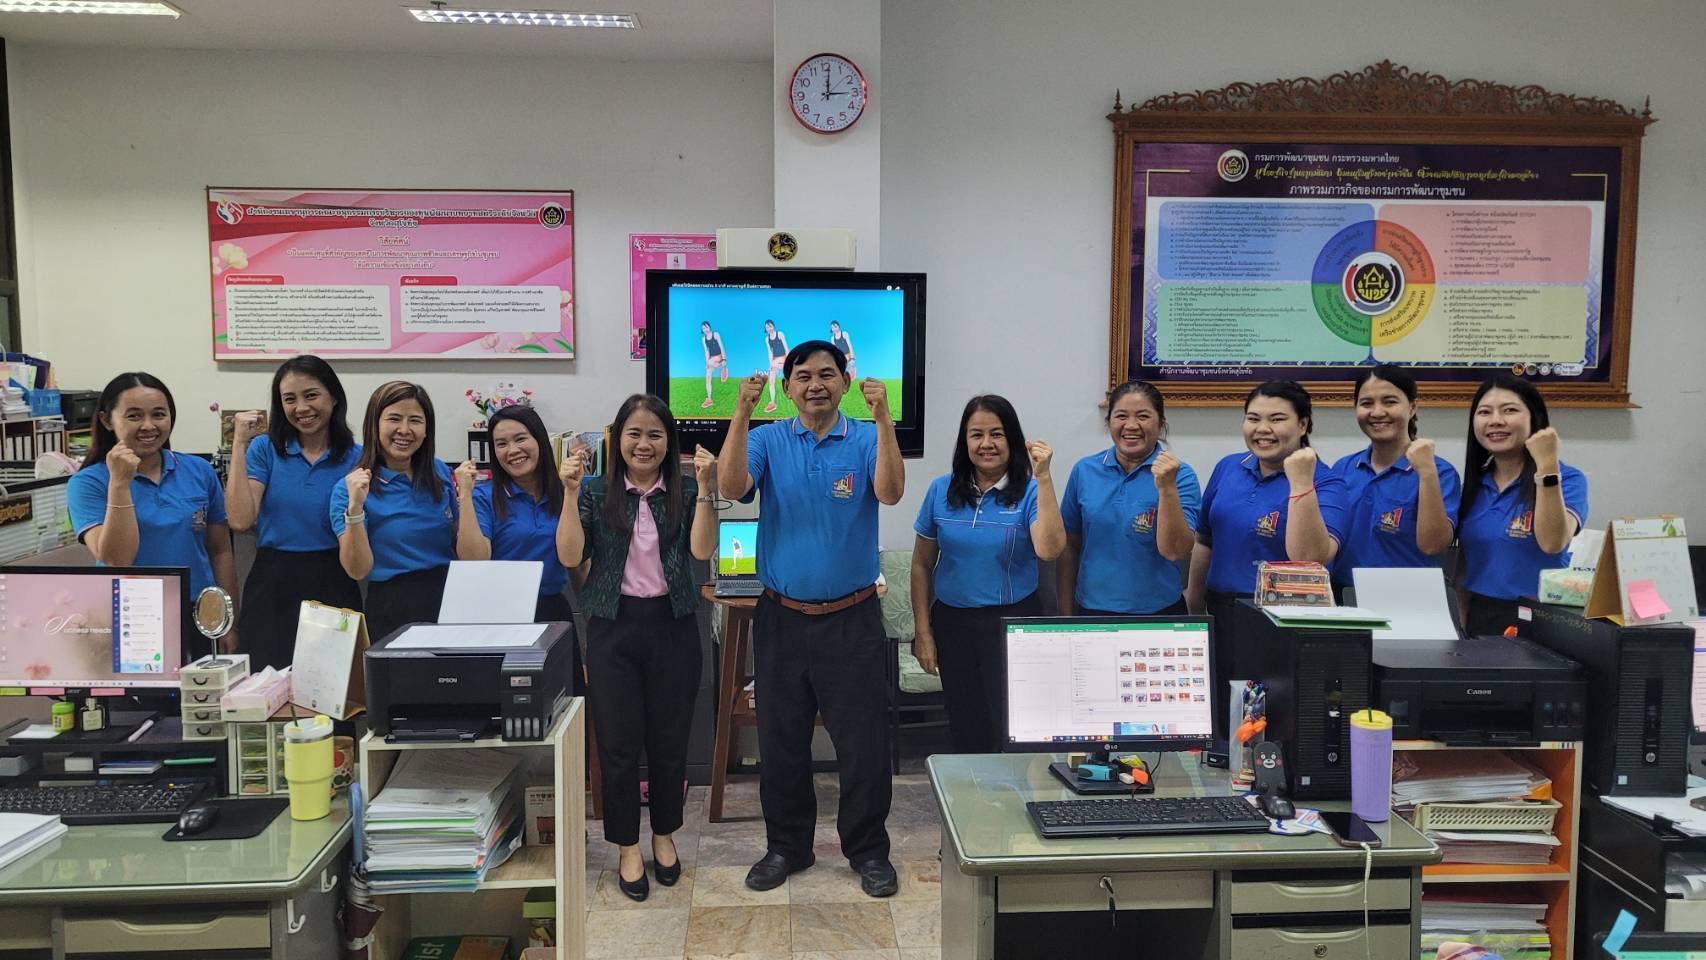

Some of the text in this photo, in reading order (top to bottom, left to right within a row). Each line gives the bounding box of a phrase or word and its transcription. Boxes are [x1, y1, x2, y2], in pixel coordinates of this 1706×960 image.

[810, 67, 817, 76] 11
[821, 62, 830, 72] 12
[838, 65, 842, 75] 1
[800, 78, 810, 87] 10
[846, 75, 853, 84] 2
[797, 91, 805, 101] 9
[851, 88, 858, 97] 3
[802, 104, 810, 114] 8
[848, 101, 854, 110] 4
[813, 113, 820, 123] 7
[826, 116, 834, 126] 6
[839, 112, 846, 121] 5
[1254, 152, 1399, 164] กรมการพัฒนาชุมชน กระทรวงมหาดไทย
[1289, 183, 1465, 199] ภาพรวมภารกิจของกรมการพัฒนาชุมชน
